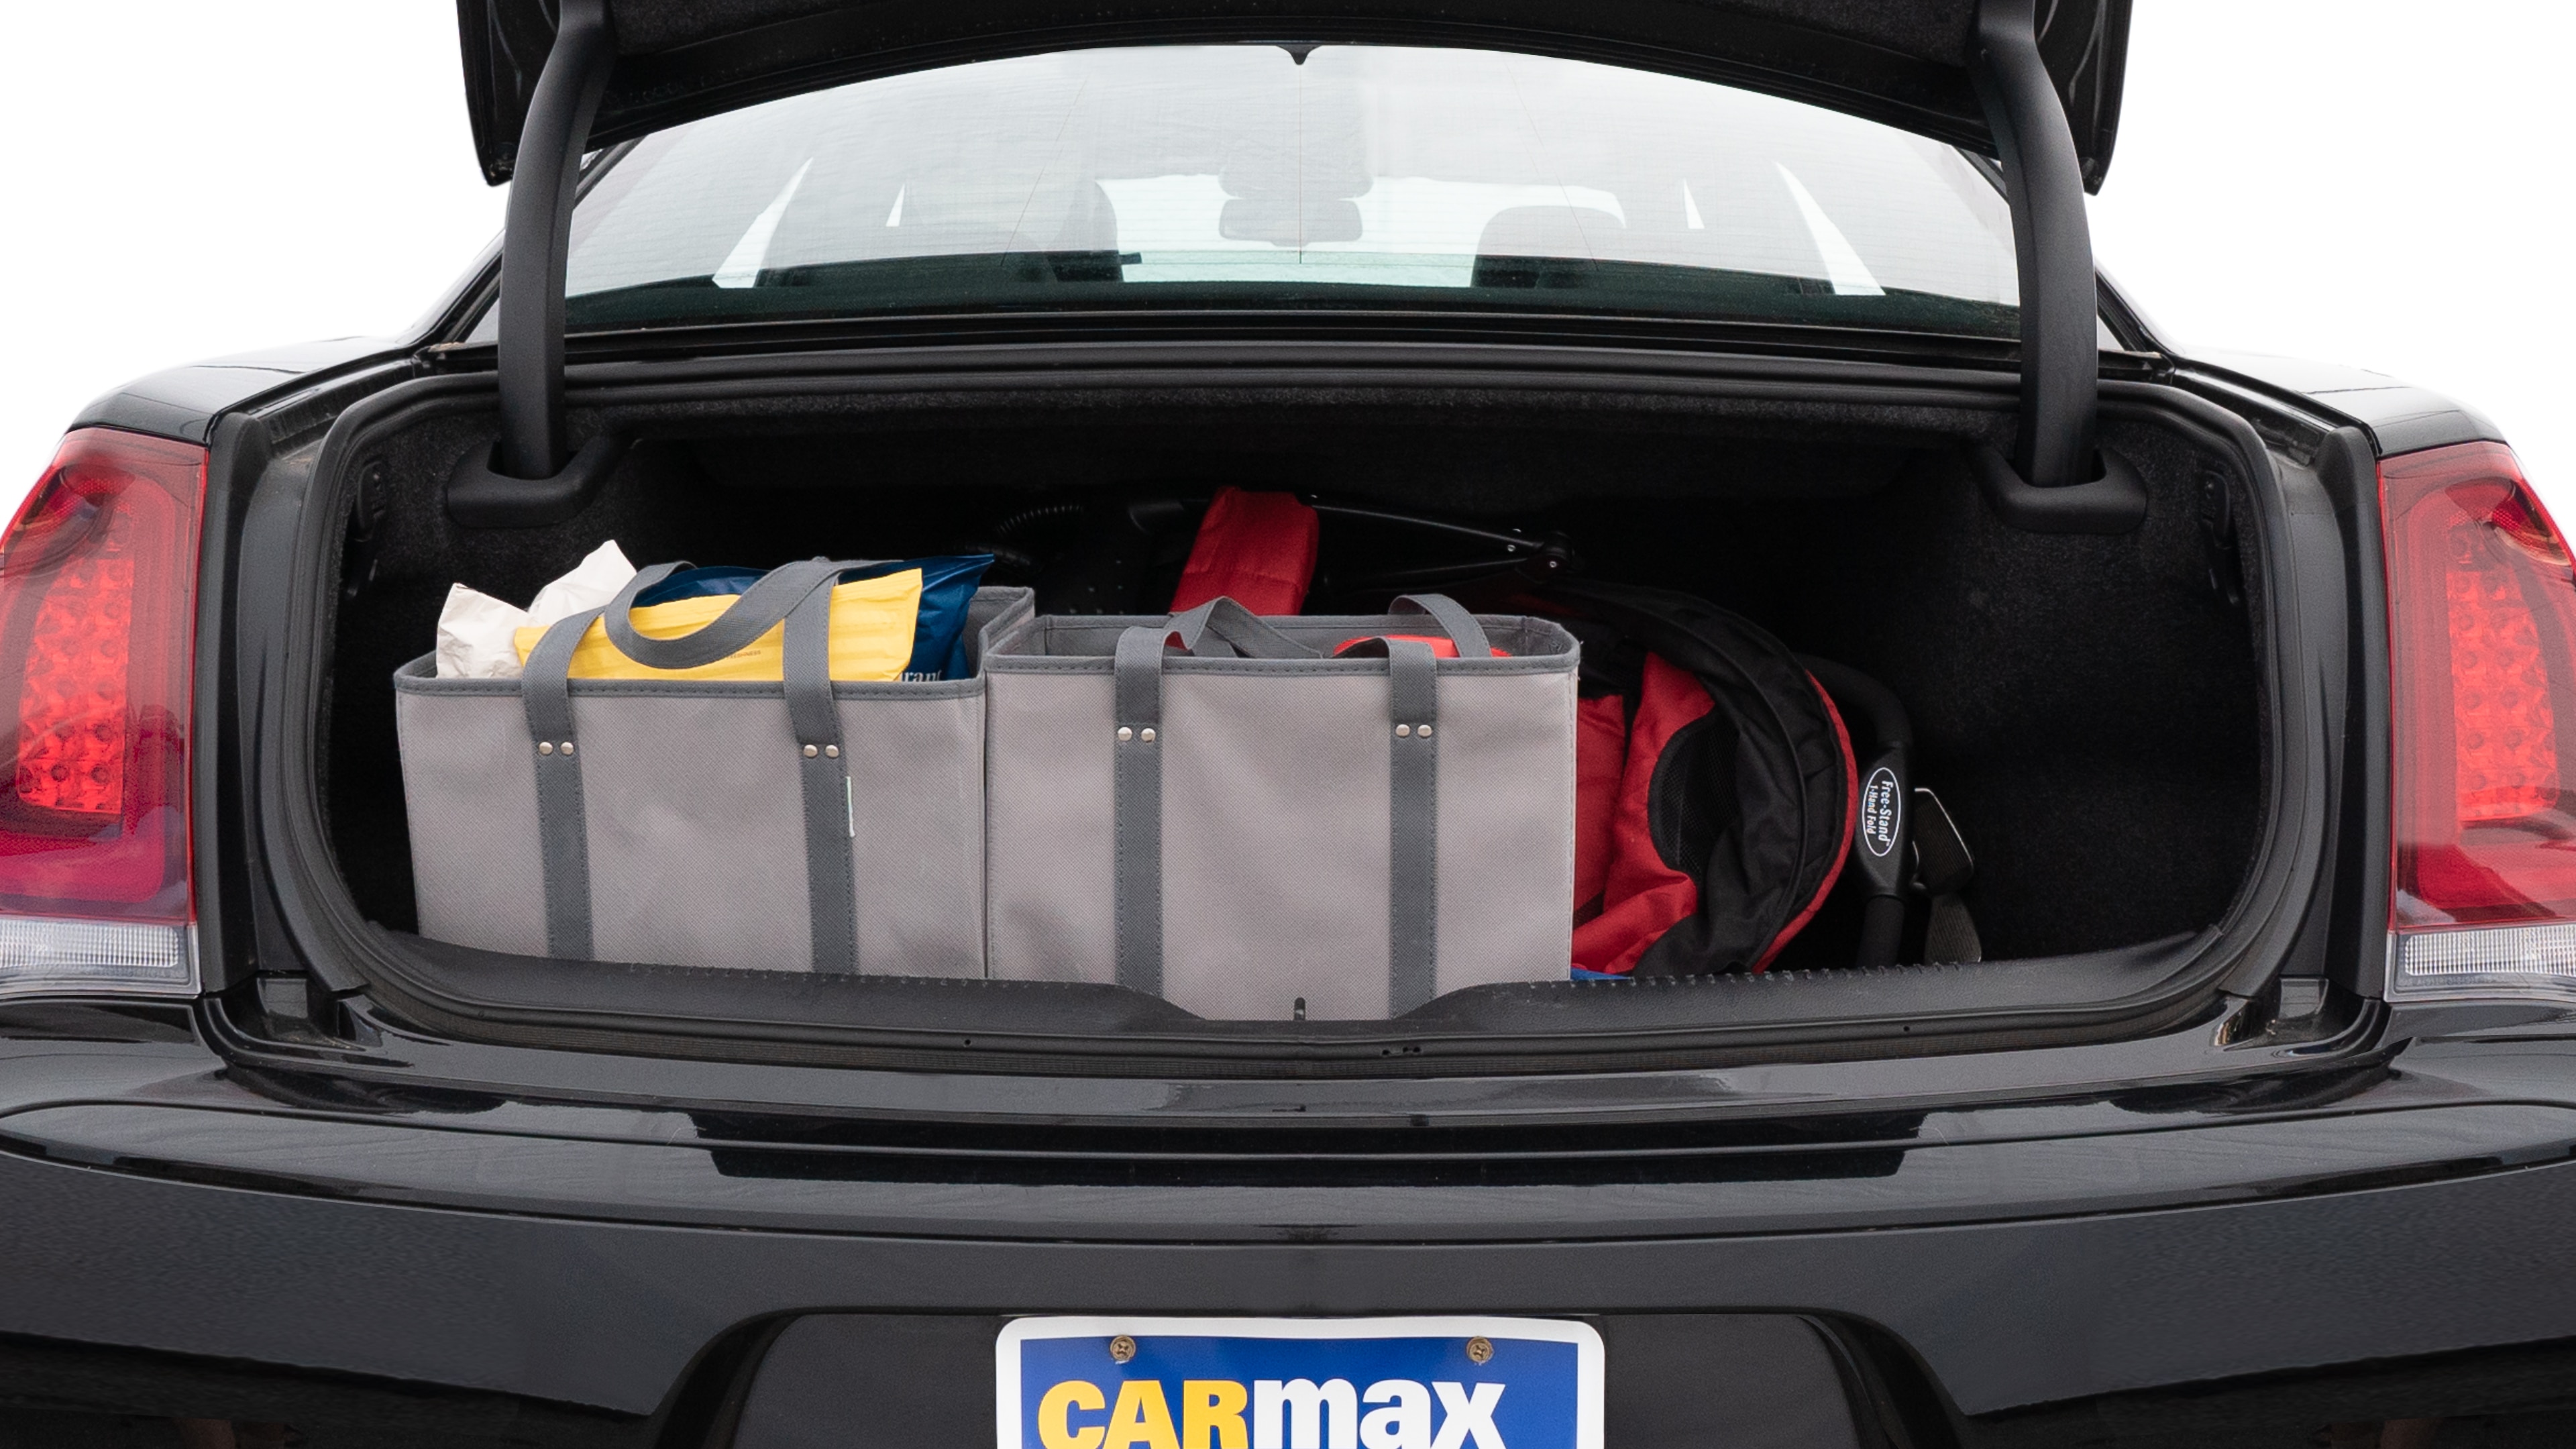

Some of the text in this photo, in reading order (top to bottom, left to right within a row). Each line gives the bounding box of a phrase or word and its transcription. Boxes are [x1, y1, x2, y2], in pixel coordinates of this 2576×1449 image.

[1866, 784, 1879, 835] 1-Hand Fold
[1038, 1379, 1506, 1449] CARmax
